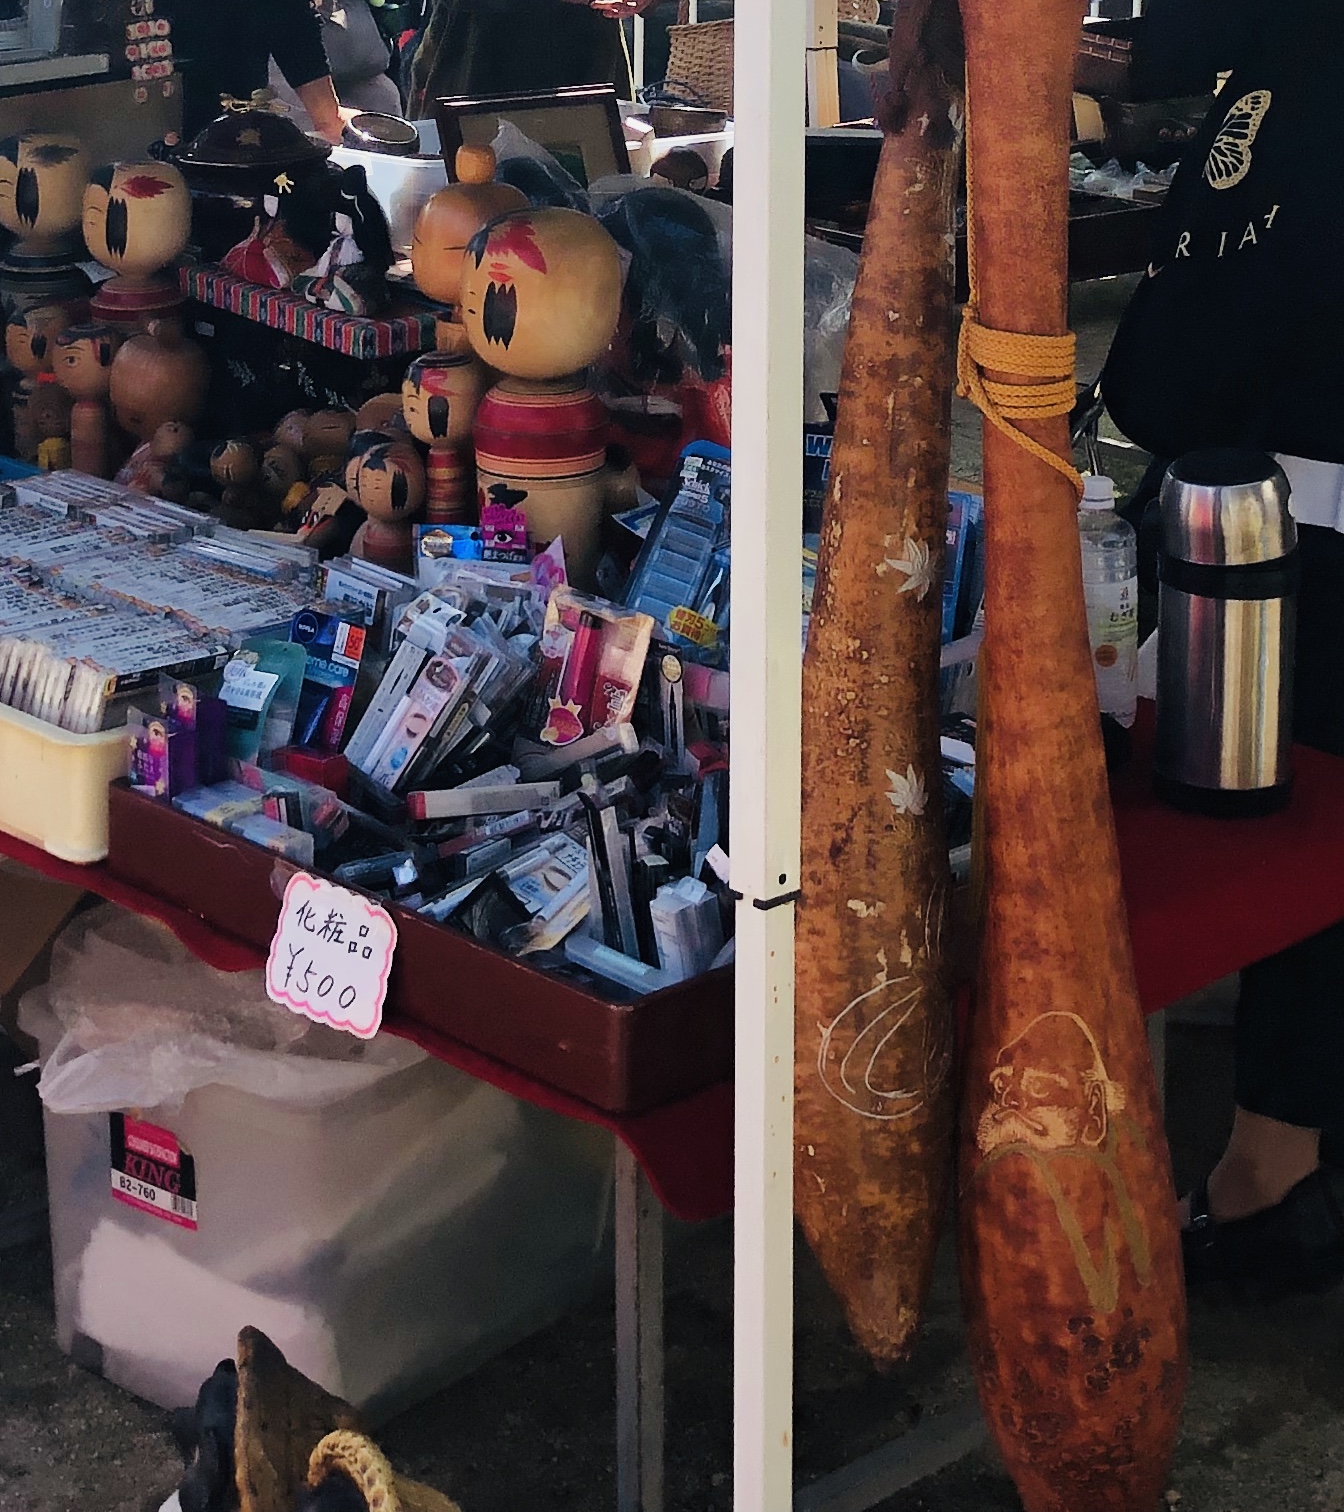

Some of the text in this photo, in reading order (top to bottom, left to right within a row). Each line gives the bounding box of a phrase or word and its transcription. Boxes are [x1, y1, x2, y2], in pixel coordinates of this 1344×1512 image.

[295, 899, 373, 960] 化粧品
[284, 943, 357, 1009] ¥500
[119, 1175, 156, 1202] B2-760
[124, 1152, 181, 1194] KING
